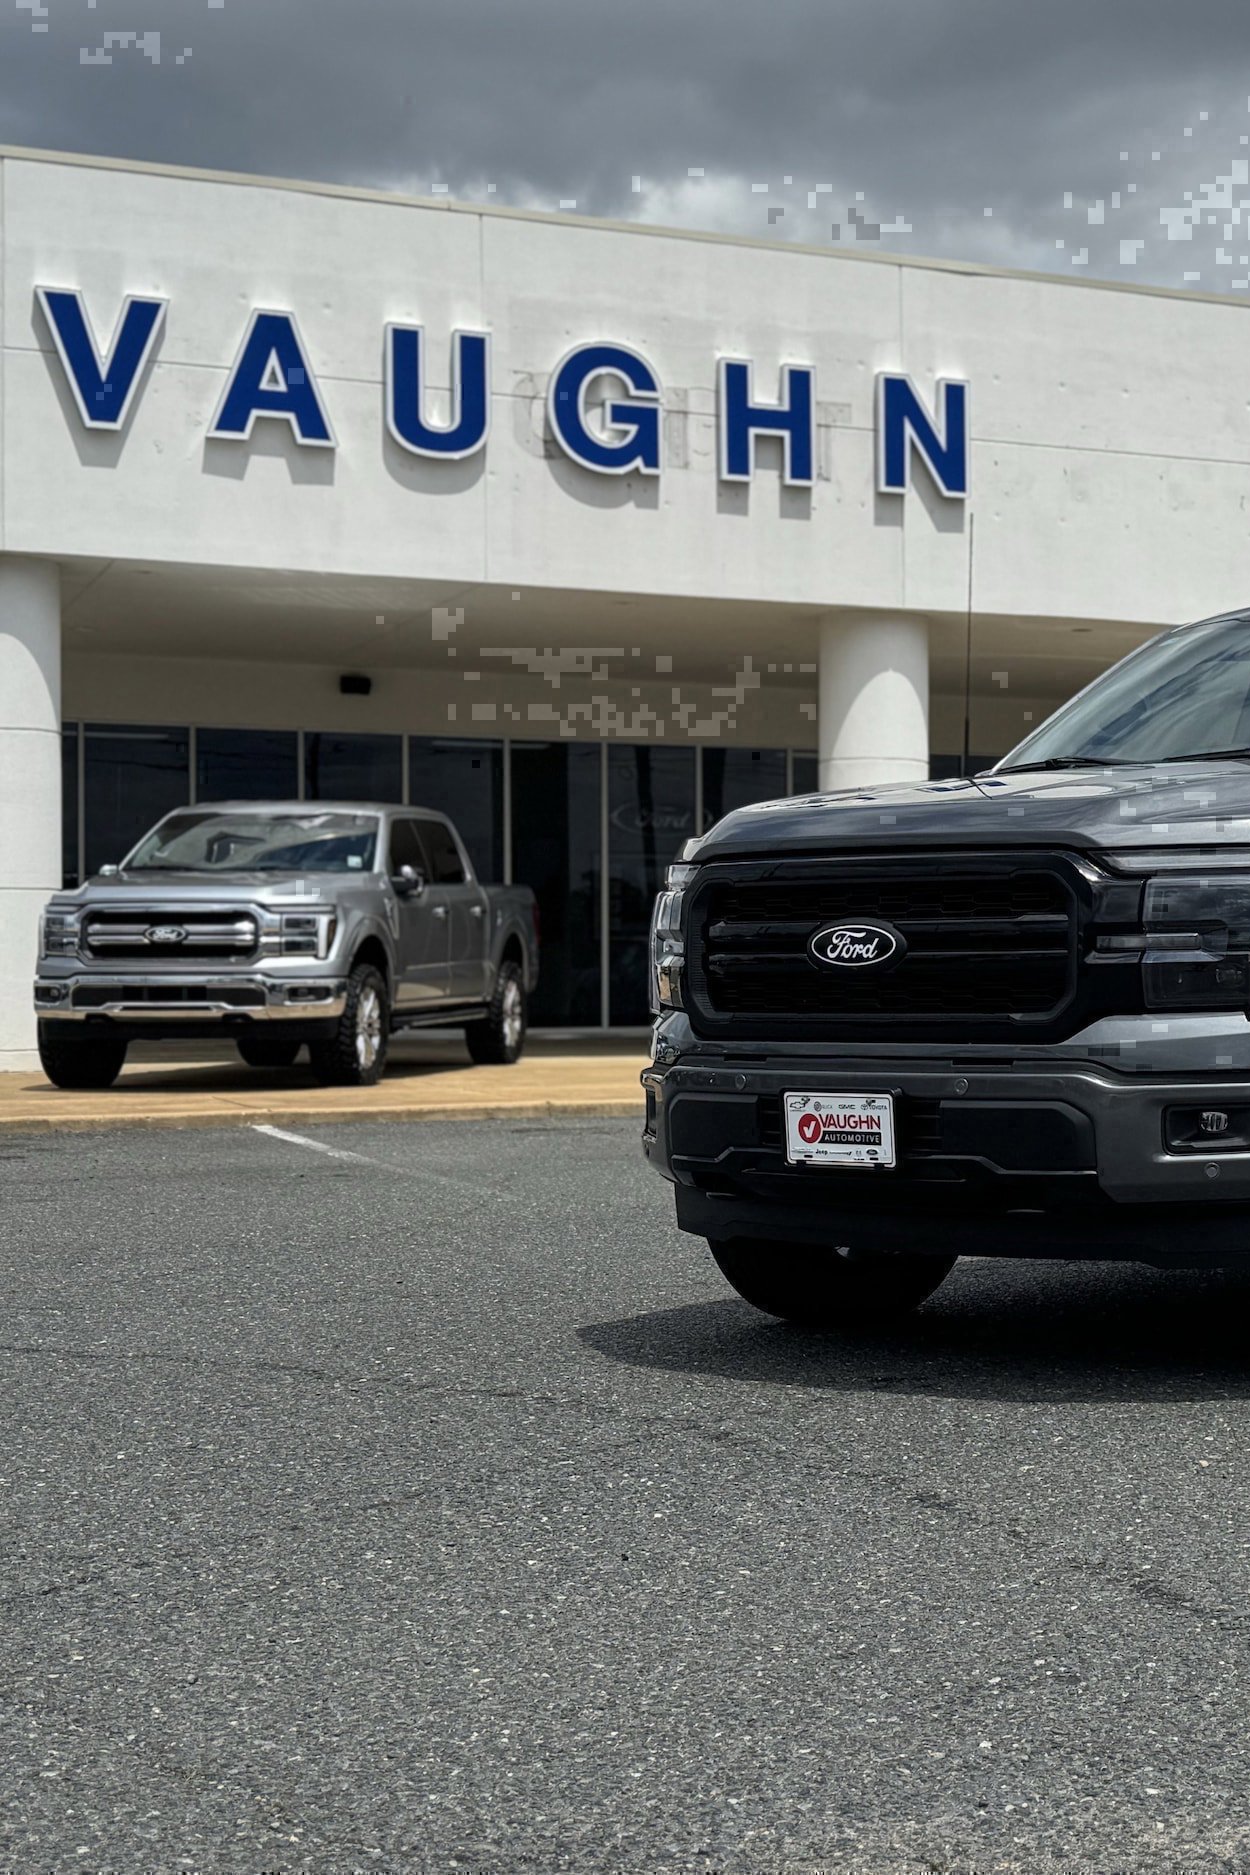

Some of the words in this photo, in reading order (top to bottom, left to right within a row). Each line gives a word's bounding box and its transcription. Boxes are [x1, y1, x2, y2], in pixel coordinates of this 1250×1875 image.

[33, 285, 971, 499] VAUGHN
[827, 931, 879, 958] Ford
[819, 1113, 881, 1130] VAUGHN
[824, 1133, 880, 1144] AUTOMOTIVE
